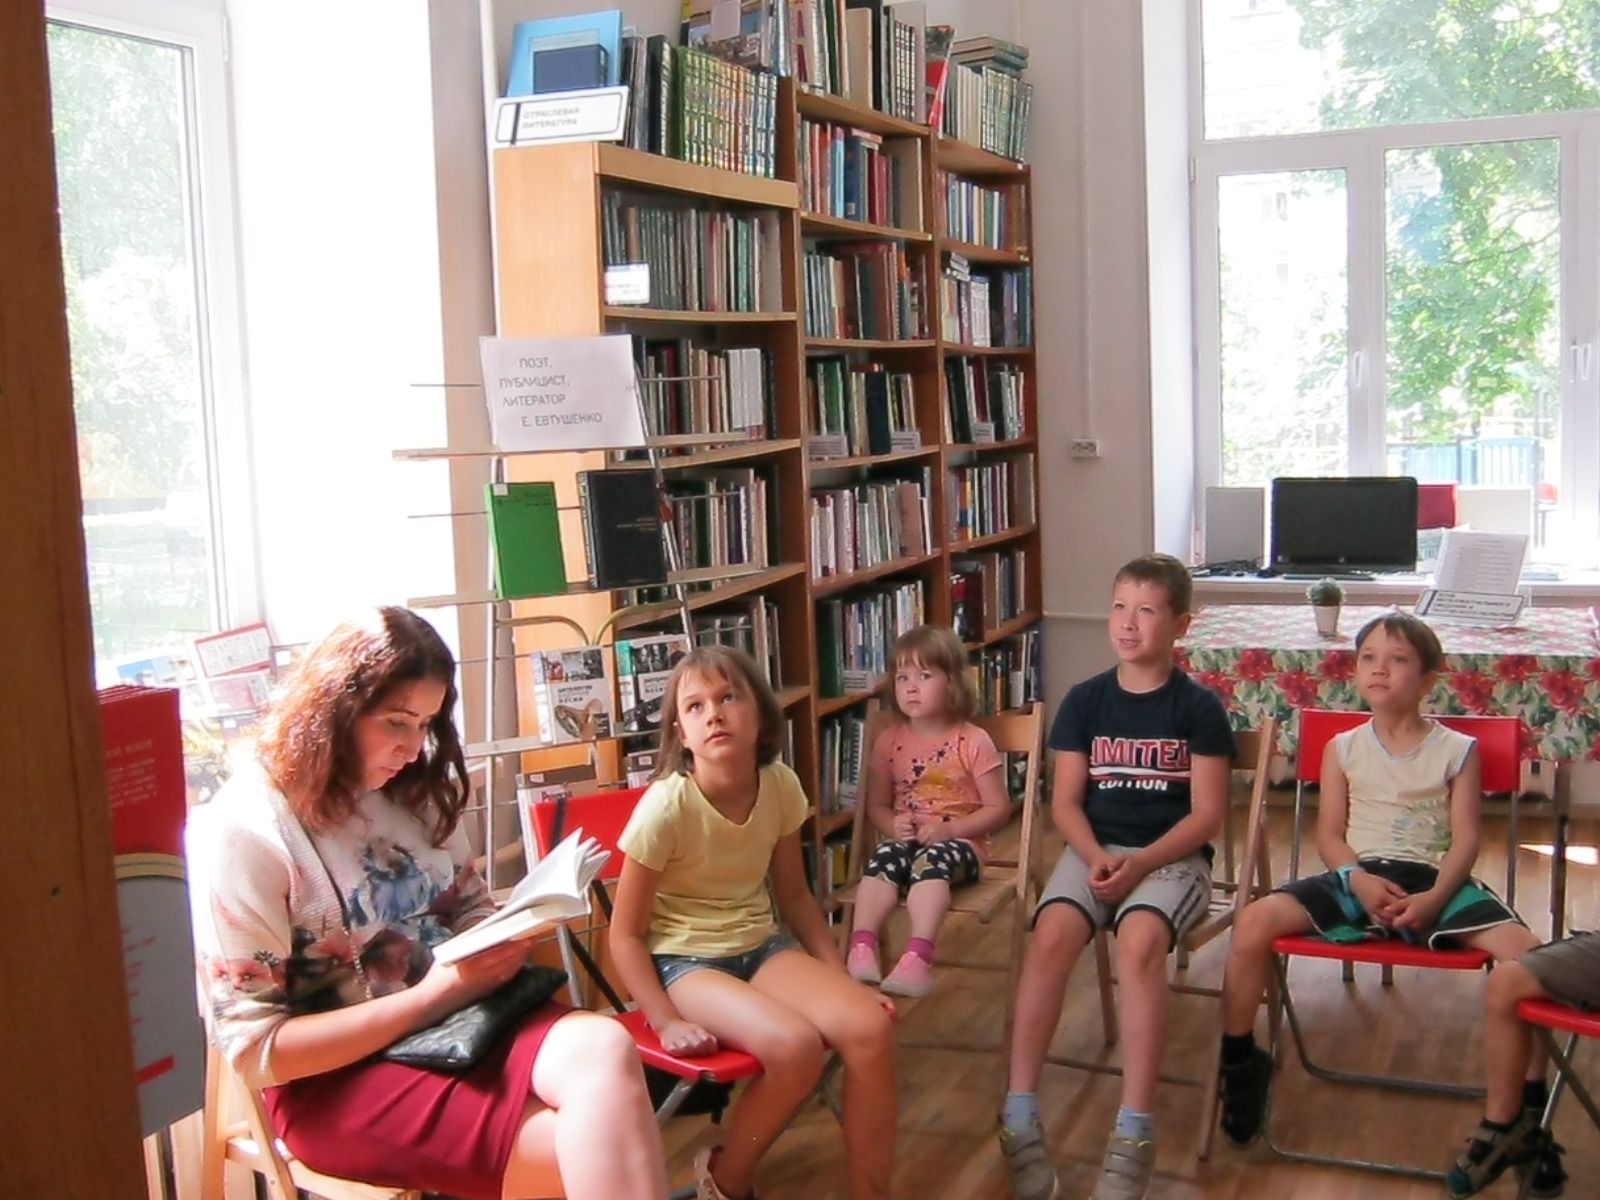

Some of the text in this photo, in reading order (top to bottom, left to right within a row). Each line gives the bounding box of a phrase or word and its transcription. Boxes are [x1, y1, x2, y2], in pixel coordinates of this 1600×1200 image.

[522, 118, 578, 129] ЛИТЕРАТУРА
[502, 393, 566, 407] ЛИТЕРАТОР
[535, 412, 603, 427] ЕВТУШЕНКО
[1090, 736, 1191, 769] IMITE
